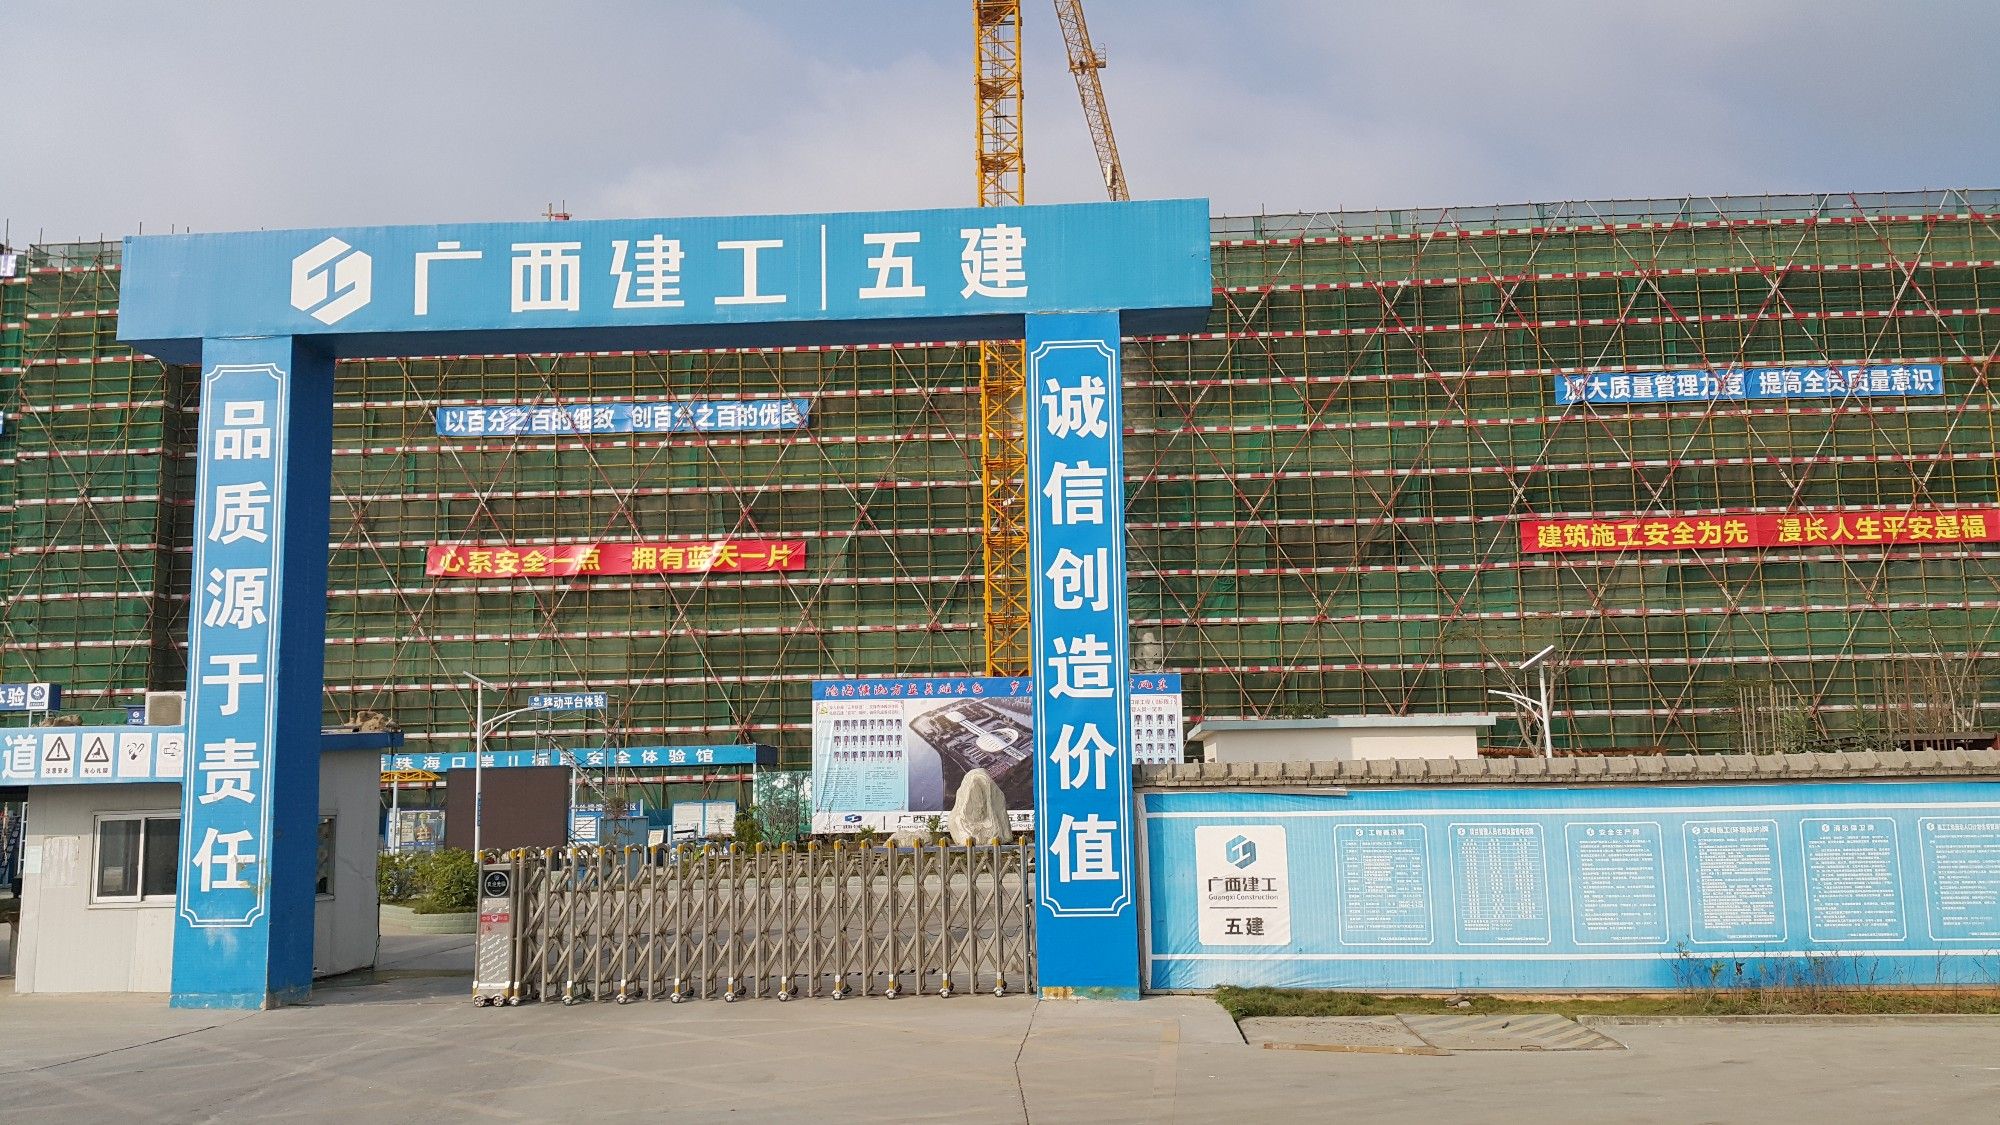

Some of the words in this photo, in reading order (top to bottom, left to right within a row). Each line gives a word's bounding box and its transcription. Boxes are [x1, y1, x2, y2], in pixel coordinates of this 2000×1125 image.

[413, 236, 788, 316] 广西建工
[857, 224, 1031, 302] 五建
[1759, 366, 1935, 394] 提高全员质量意识
[445, 405, 615, 433] 以百分之百的细致
[631, 402, 801, 430] 创百分之百的优良
[1537, 519, 1749, 548] 建筑施工安全为先
[1777, 514, 1987, 542] 漫长人生平安是福
[439, 547, 601, 575] 心系安全一点
[631, 544, 793, 571] 拥有蓝天一片
[1041, 374, 1122, 884] 诚信创造价值
[192, 399, 273, 894] 品质源于责任
[0, 686, 26, 707] 验
[543, 694, 605, 709] 移动平台体验
[2, 734, 38, 779] 道
[1208, 876, 1278, 892] 广西建工
[1208, 893, 1236, 902] Guangxi
[1236, 893, 1279, 901] Construction
[1224, 917, 1265, 936] 五建
